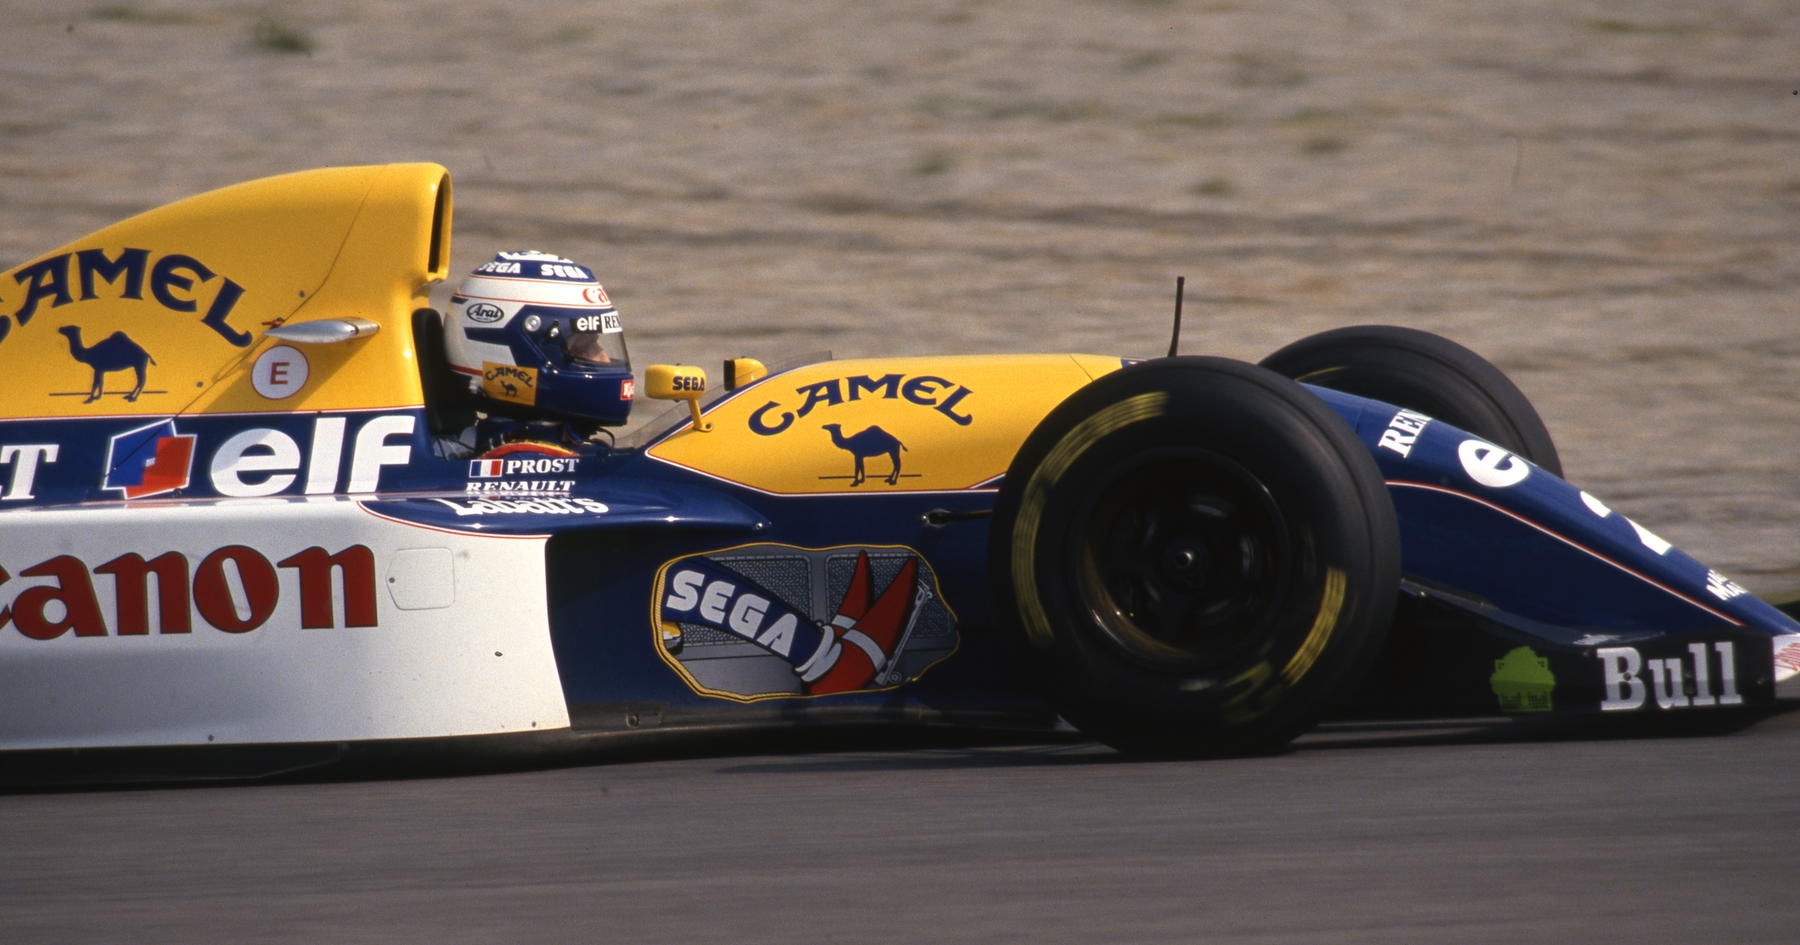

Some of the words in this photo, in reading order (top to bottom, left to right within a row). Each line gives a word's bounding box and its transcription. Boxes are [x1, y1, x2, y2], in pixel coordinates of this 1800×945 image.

[0, 248, 252, 348] AMEL
[582, 287, 608, 304] Ca
[470, 303, 500, 318] Arai
[576, 316, 601, 331] elf
[270, 362, 290, 385] E
[485, 367, 533, 388] CAMEL
[672, 375, 705, 391] SEGA
[748, 374, 973, 436] CAMEL
[210, 415, 416, 497] elf
[505, 458, 580, 475] PROST
[0, 444, 60, 500] T
[465, 480, 576, 493] RENAULT
[0, 544, 378, 640] anon
[666, 569, 798, 657] SEGA
[1596, 640, 1742, 711] Bull
